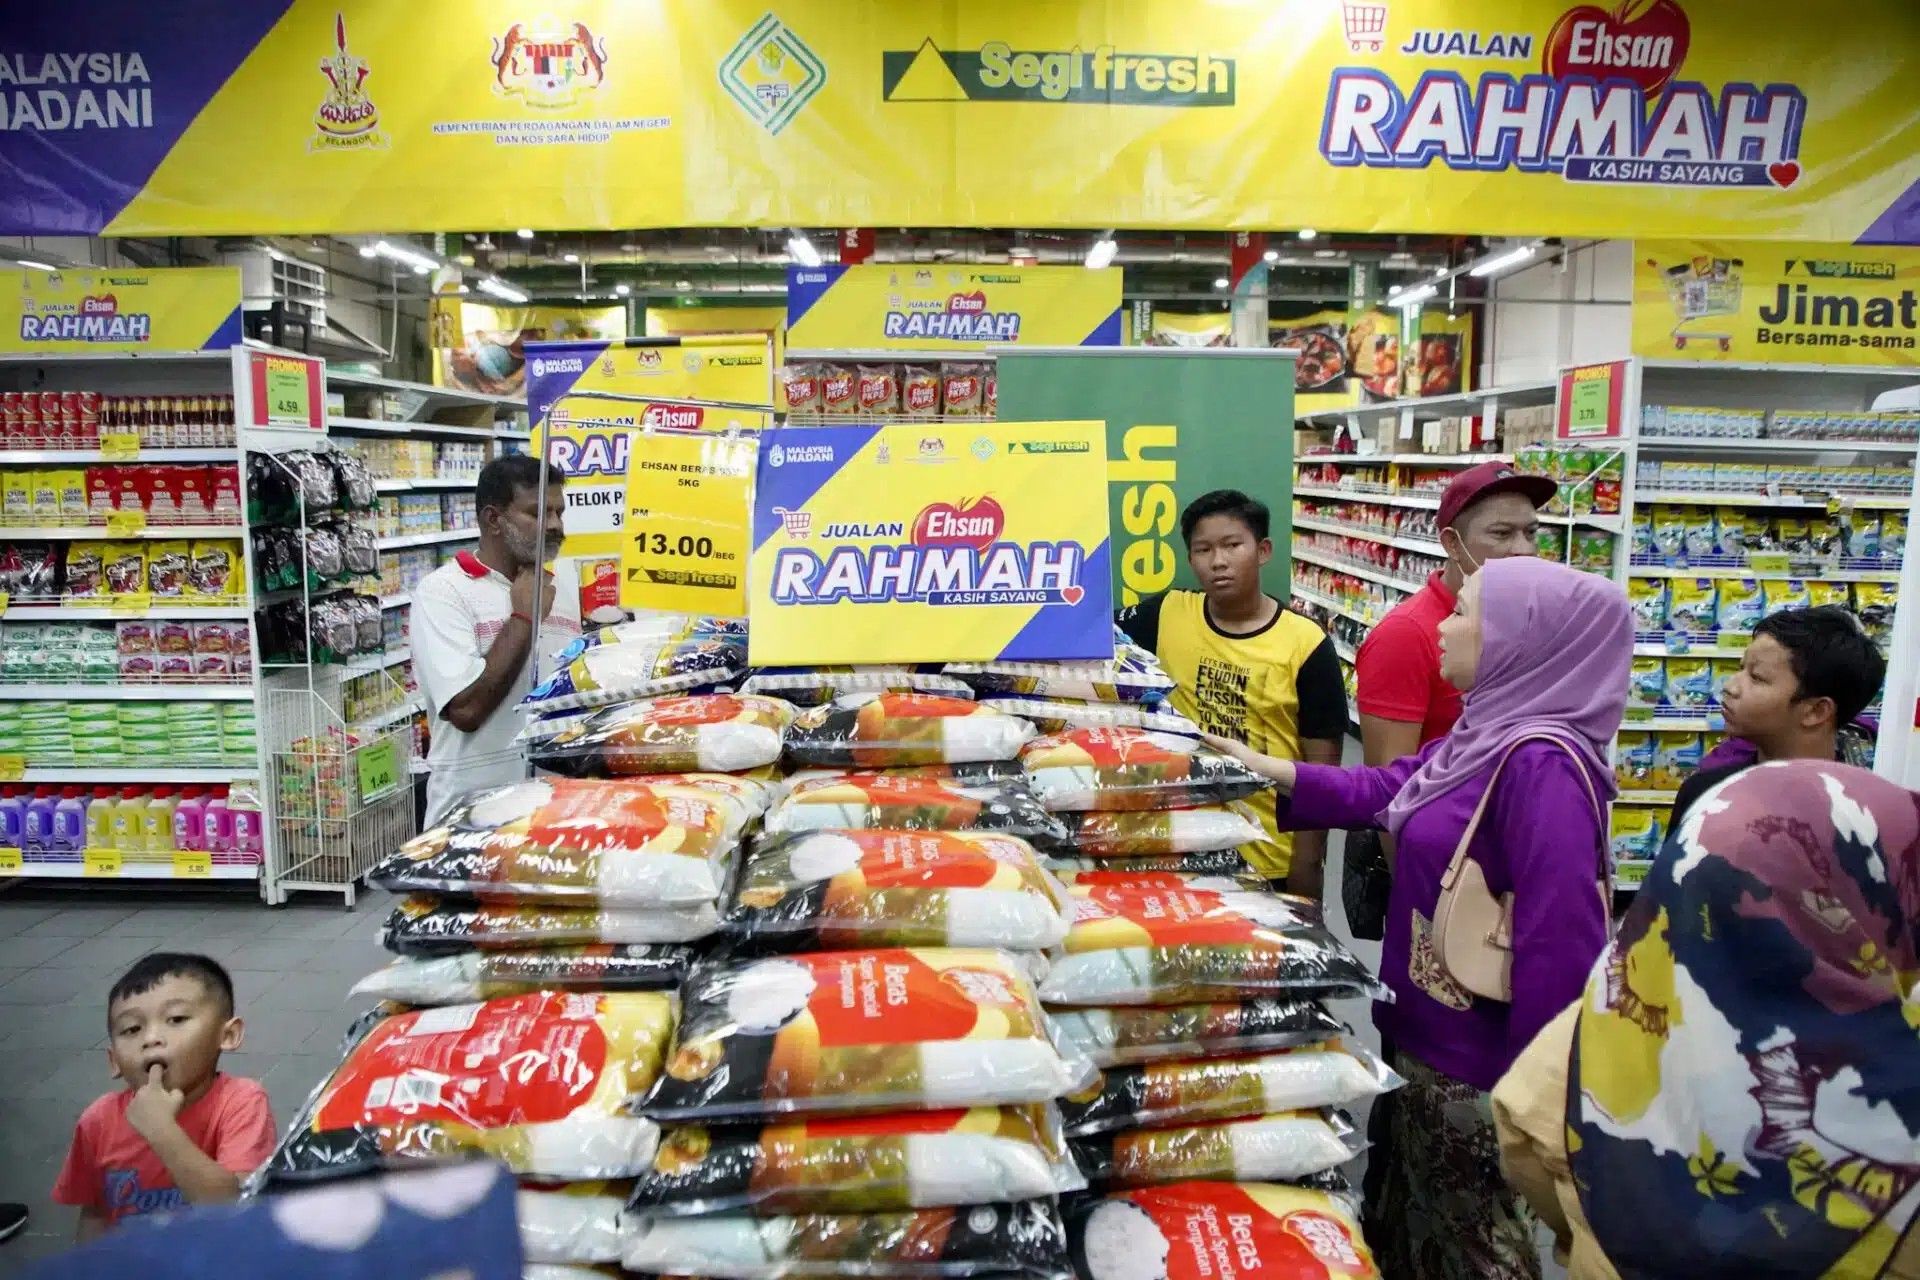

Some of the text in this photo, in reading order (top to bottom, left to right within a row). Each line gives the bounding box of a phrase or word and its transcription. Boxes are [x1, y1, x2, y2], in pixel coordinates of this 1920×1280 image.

[1402, 31, 1532, 59] JUALAN
[1567, 20, 1675, 69] Ehsan
[980, 41, 1229, 99] Segi fresh
[1322, 68, 1806, 172] RAHMAH
[521, 134, 544, 144] KOS
[1588, 161, 1745, 184] KASIH SAYANG
[1849, 260, 1894, 275] fresh
[1758, 283, 1918, 329] Jimat
[22, 314, 150, 339] RAHMAH
[886, 312, 1020, 338] RAHMAH
[1757, 328, 1916, 349] Bersama-sama
[278, 400, 299, 413] 4.59
[651, 410, 697, 429] Ehsan
[786, 446, 833, 455] MALAYSIA
[786, 453, 834, 462] MADANI
[641, 461, 677, 472] EHSAN
[678, 478, 700, 488] 5KG
[566, 492, 611, 507] TELOK
[821, 523, 902, 537] JUALAN
[926, 511, 994, 538] Ehsan
[634, 532, 713, 559] 13.00
[692, 572, 736, 586] fresh
[771, 542, 1085, 604] RAHMAH
[943, 589, 1047, 603] KASIH SAYANG
[884, 964, 910, 1006] Beras
[1227, 1213, 1262, 1270] Beras
